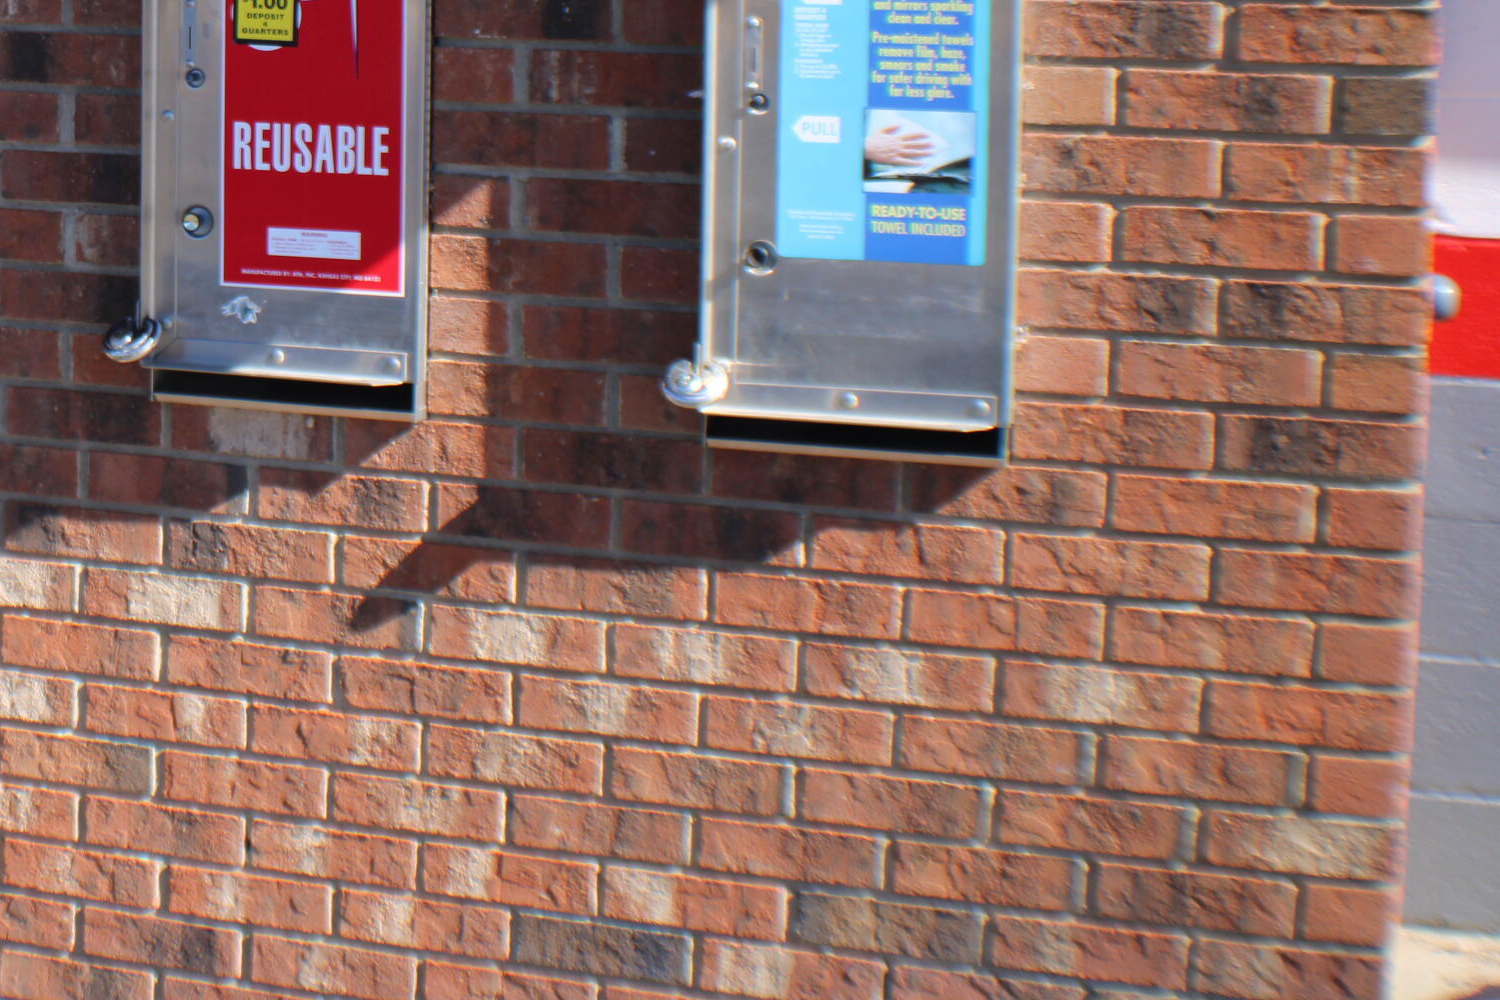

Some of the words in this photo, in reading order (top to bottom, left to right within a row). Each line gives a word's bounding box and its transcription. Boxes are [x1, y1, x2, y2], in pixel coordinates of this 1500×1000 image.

[894, 0, 928, 11] mirrors
[930, 0, 974, 15] sparkling
[914, 12, 932, 24] and
[242, 27, 289, 36] QUARTERS
[943, 33, 974, 46] towels
[880, 49, 914, 57] remove
[880, 62, 913, 70] smears
[915, 59, 933, 71] and
[935, 60, 966, 72] smoke
[872, 70, 886, 83] for
[916, 72, 948, 88] driving
[951, 73, 973, 85] with
[905, 84, 925, 97] less
[802, 122, 837, 137] PULL
[232, 120, 390, 176] REUSABLE
[871, 205, 967, 221] READY-TO-USE
[871, 221, 908, 235] TOWEL
[912, 222, 966, 237] INCLUDED
